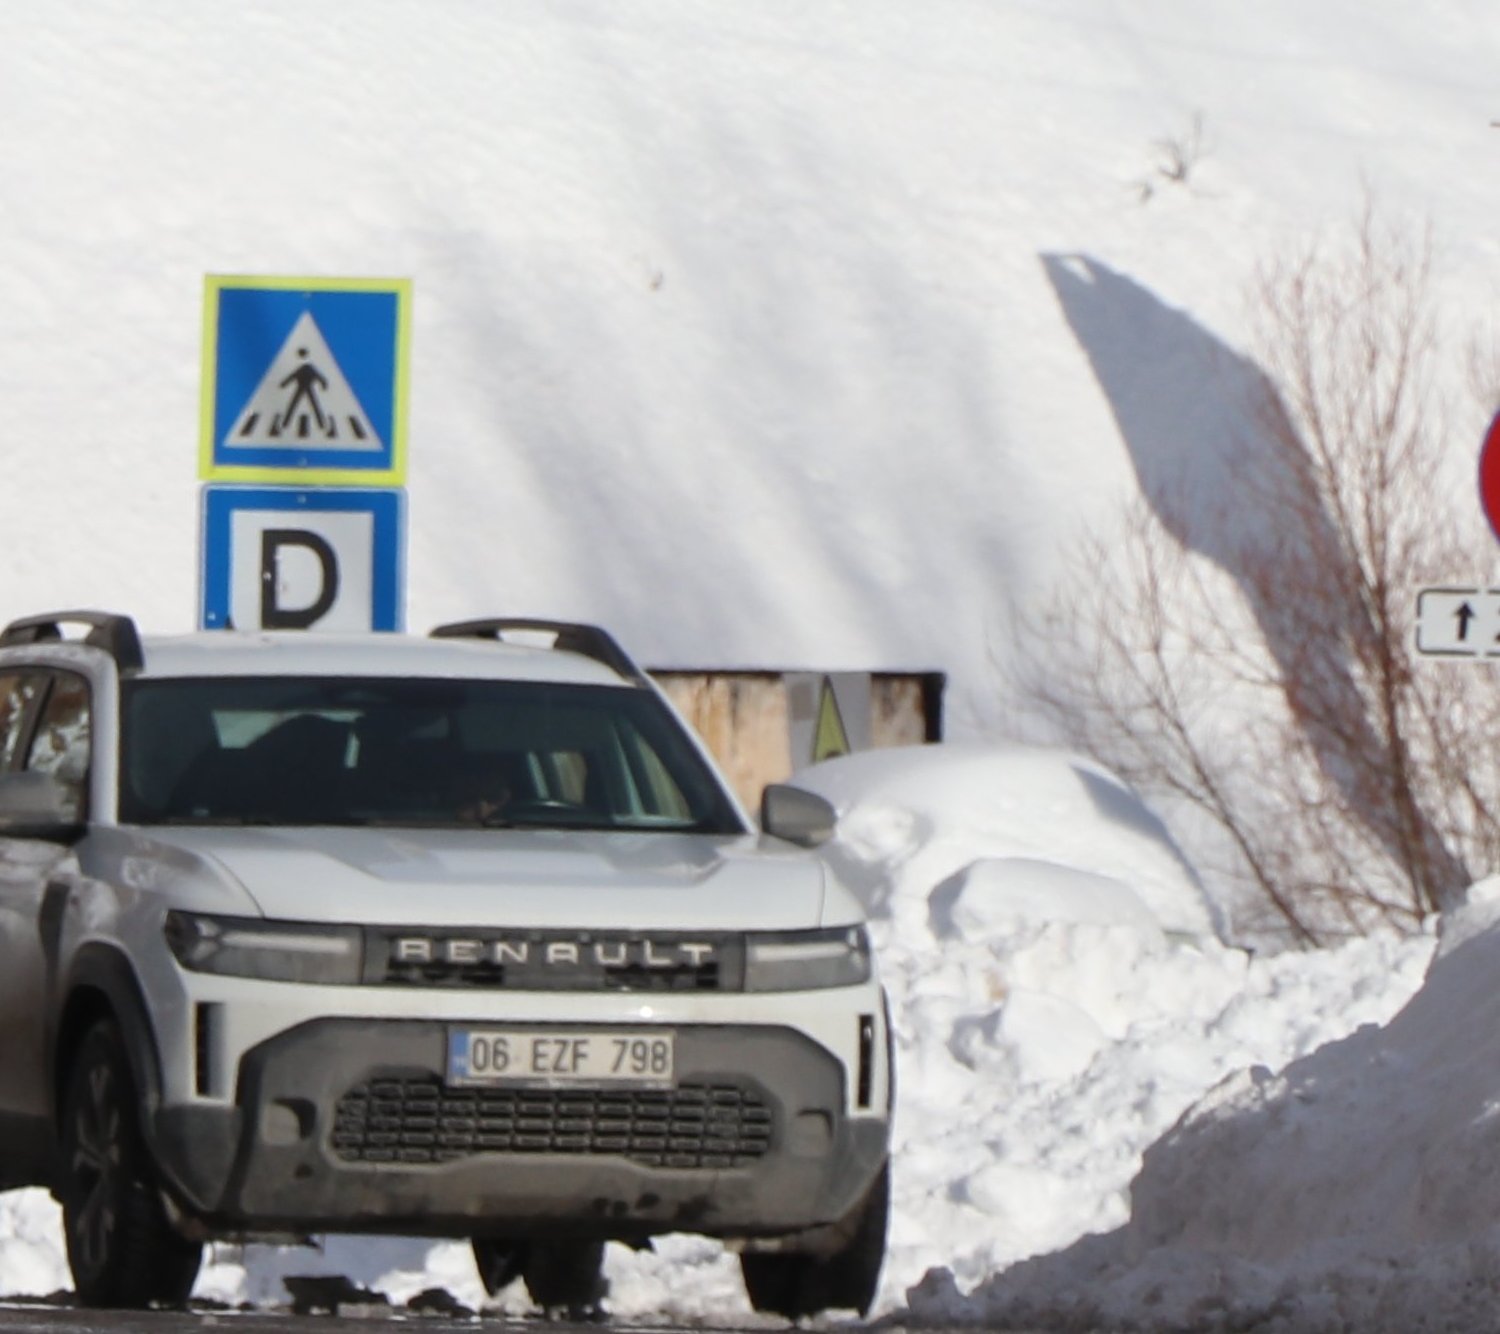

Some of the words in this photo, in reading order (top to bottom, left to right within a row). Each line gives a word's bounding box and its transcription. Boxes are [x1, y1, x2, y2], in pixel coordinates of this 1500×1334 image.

[261, 528, 339, 630] D
[398, 937, 713, 967] RENAULT
[471, 1037, 510, 1071] 06
[531, 1038, 590, 1073] EZF
[611, 1039, 669, 1074] 798
